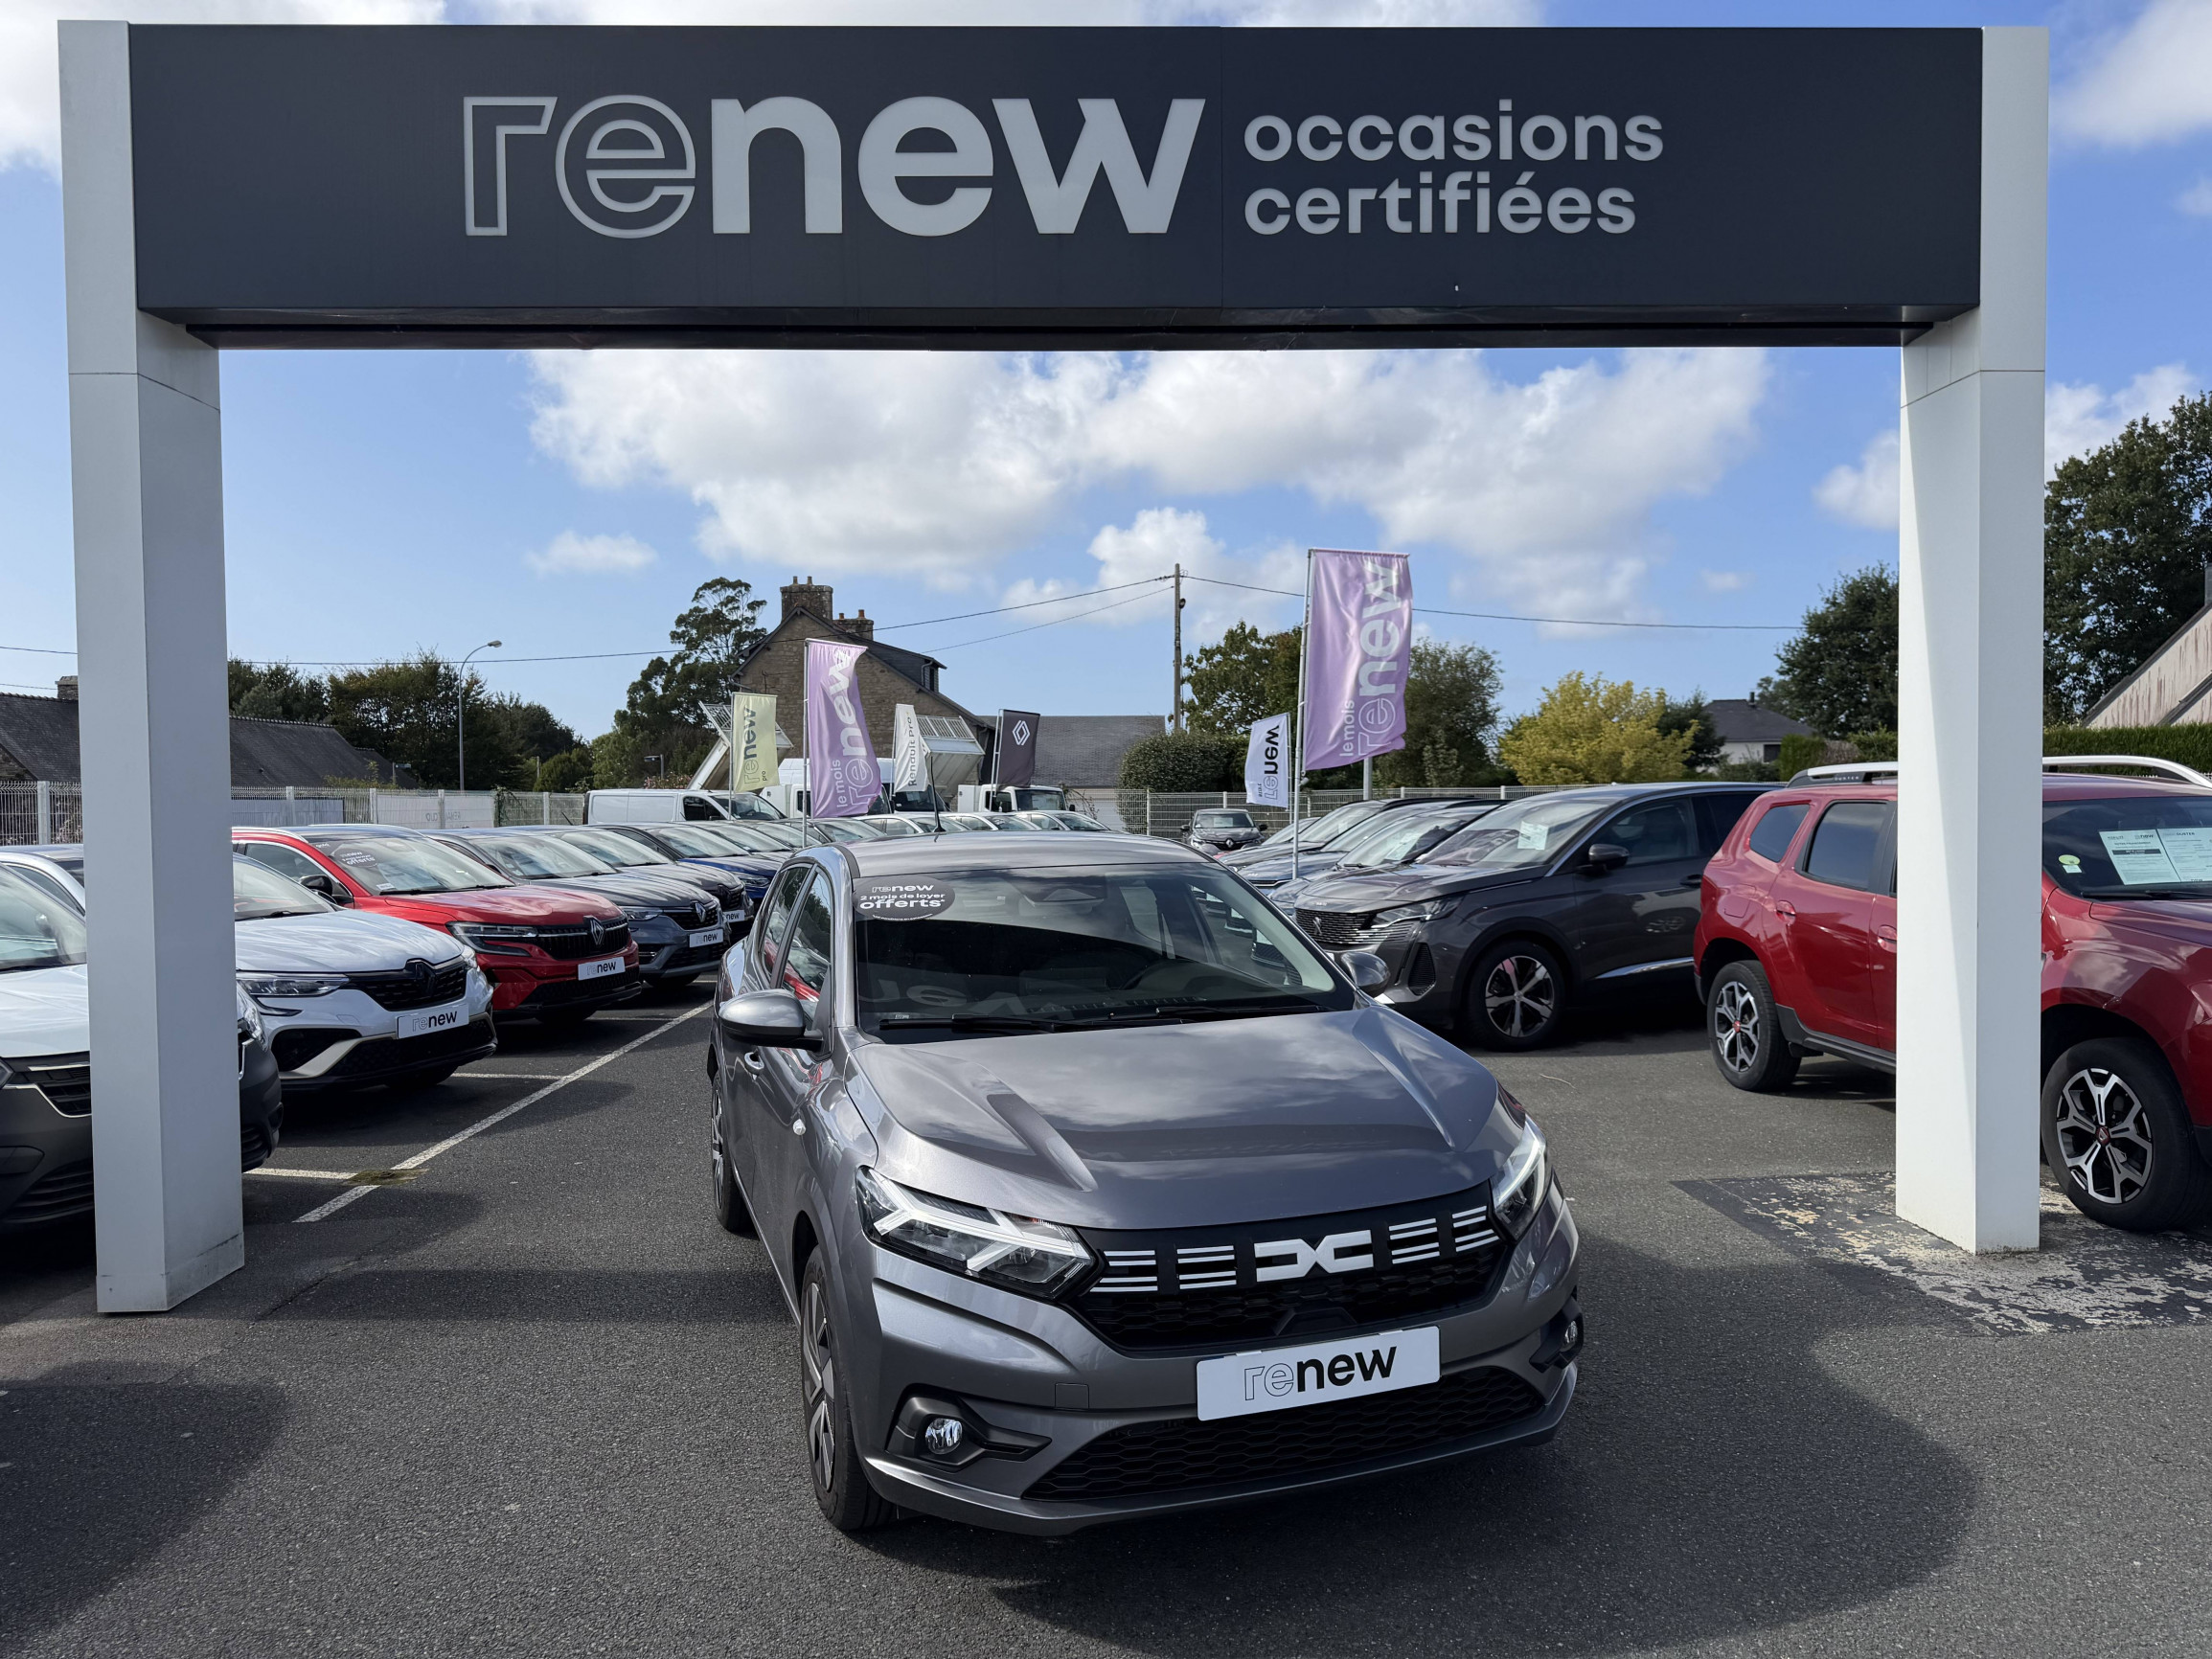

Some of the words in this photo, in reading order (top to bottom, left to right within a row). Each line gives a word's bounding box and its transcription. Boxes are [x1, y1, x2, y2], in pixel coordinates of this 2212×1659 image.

[1243, 98, 1665, 164] occasions
[463, 94, 1206, 240] renew
[1243, 170, 1637, 237] certifiées
[1358, 558, 1402, 757] renew
[743, 704, 760, 784] renew
[828, 648, 877, 806] renew
[1341, 699, 1356, 741] mois
[907, 739, 918, 787] Renault
[1339, 742, 1354, 757] le
[831, 759, 846, 793] mois
[836, 795, 848, 808] le
[871, 884, 935, 893] renew
[586, 961, 617, 977] renew
[412, 1011, 458, 1033] renew
[1243, 1345, 1398, 1401] renew
